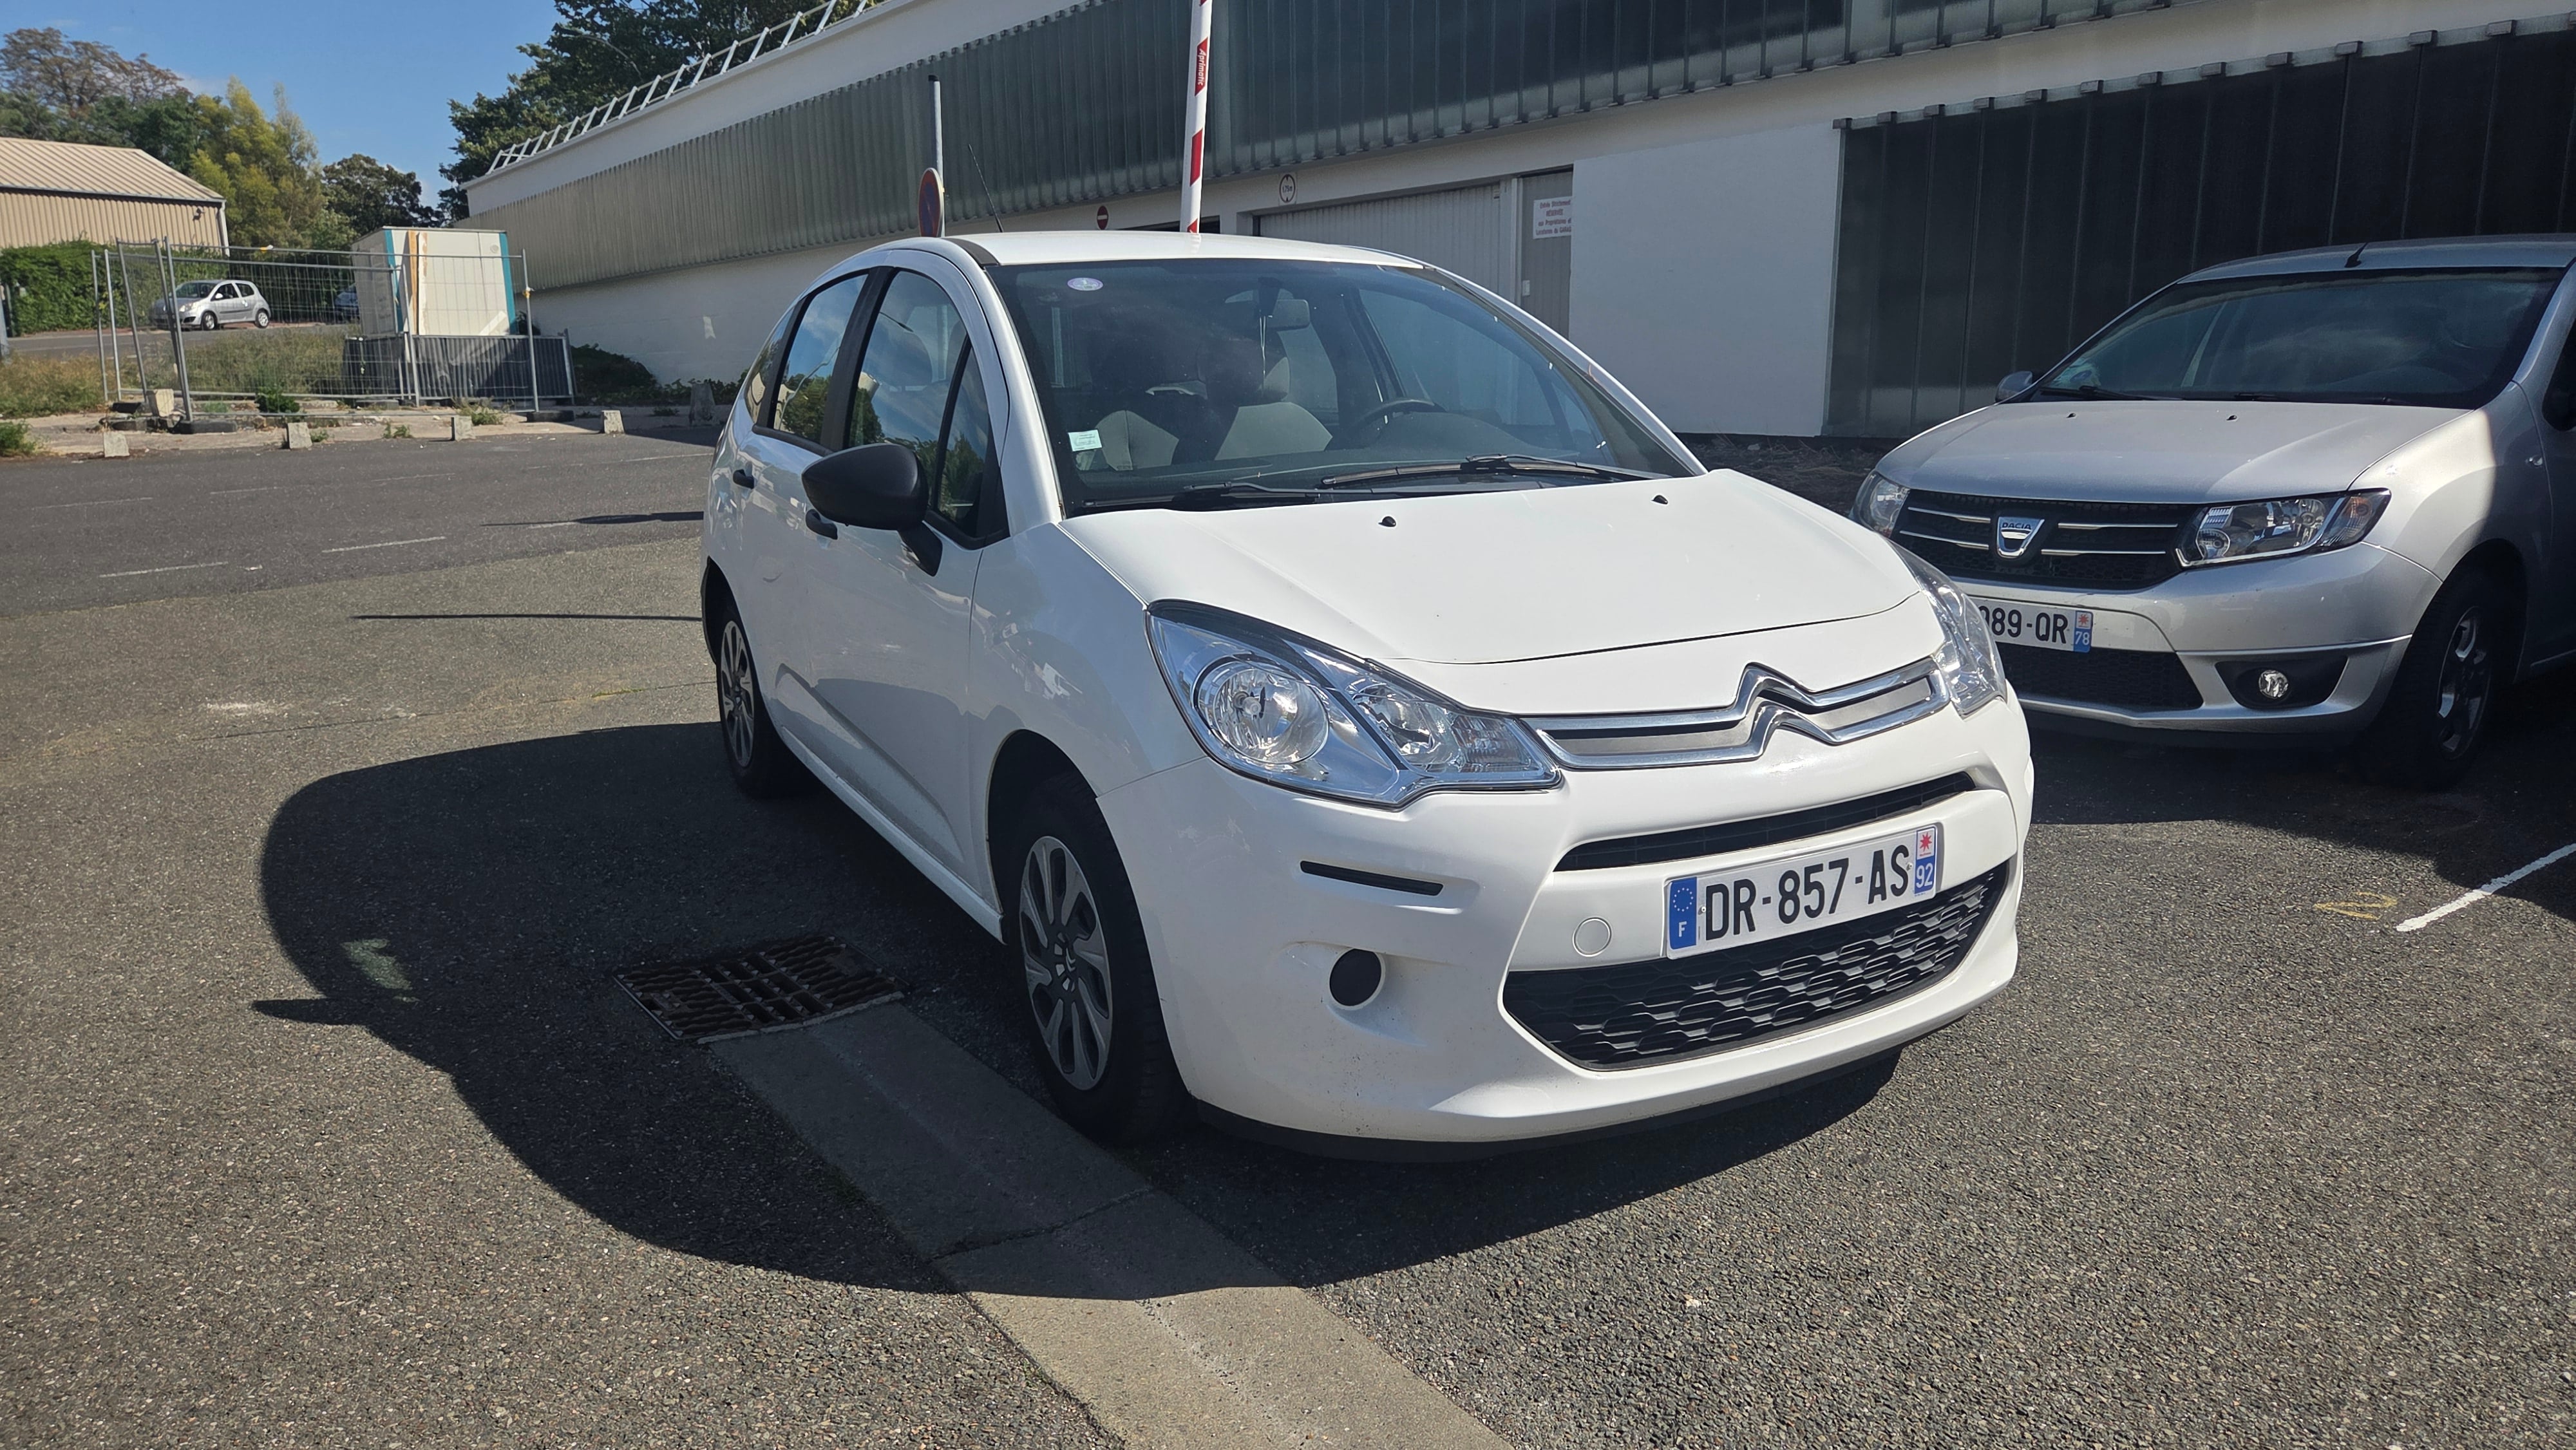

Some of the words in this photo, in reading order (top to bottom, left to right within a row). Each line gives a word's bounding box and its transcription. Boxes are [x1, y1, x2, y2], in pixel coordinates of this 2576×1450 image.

[1198, 48, 1206, 86] Aprimatic
[2002, 522, 2032, 530] DACIA
[2075, 631, 2090, 645] 78
[1916, 863, 1933, 888] 92
[1705, 844, 1910, 941] DR-857-AS
[1678, 921, 1687, 937] F
